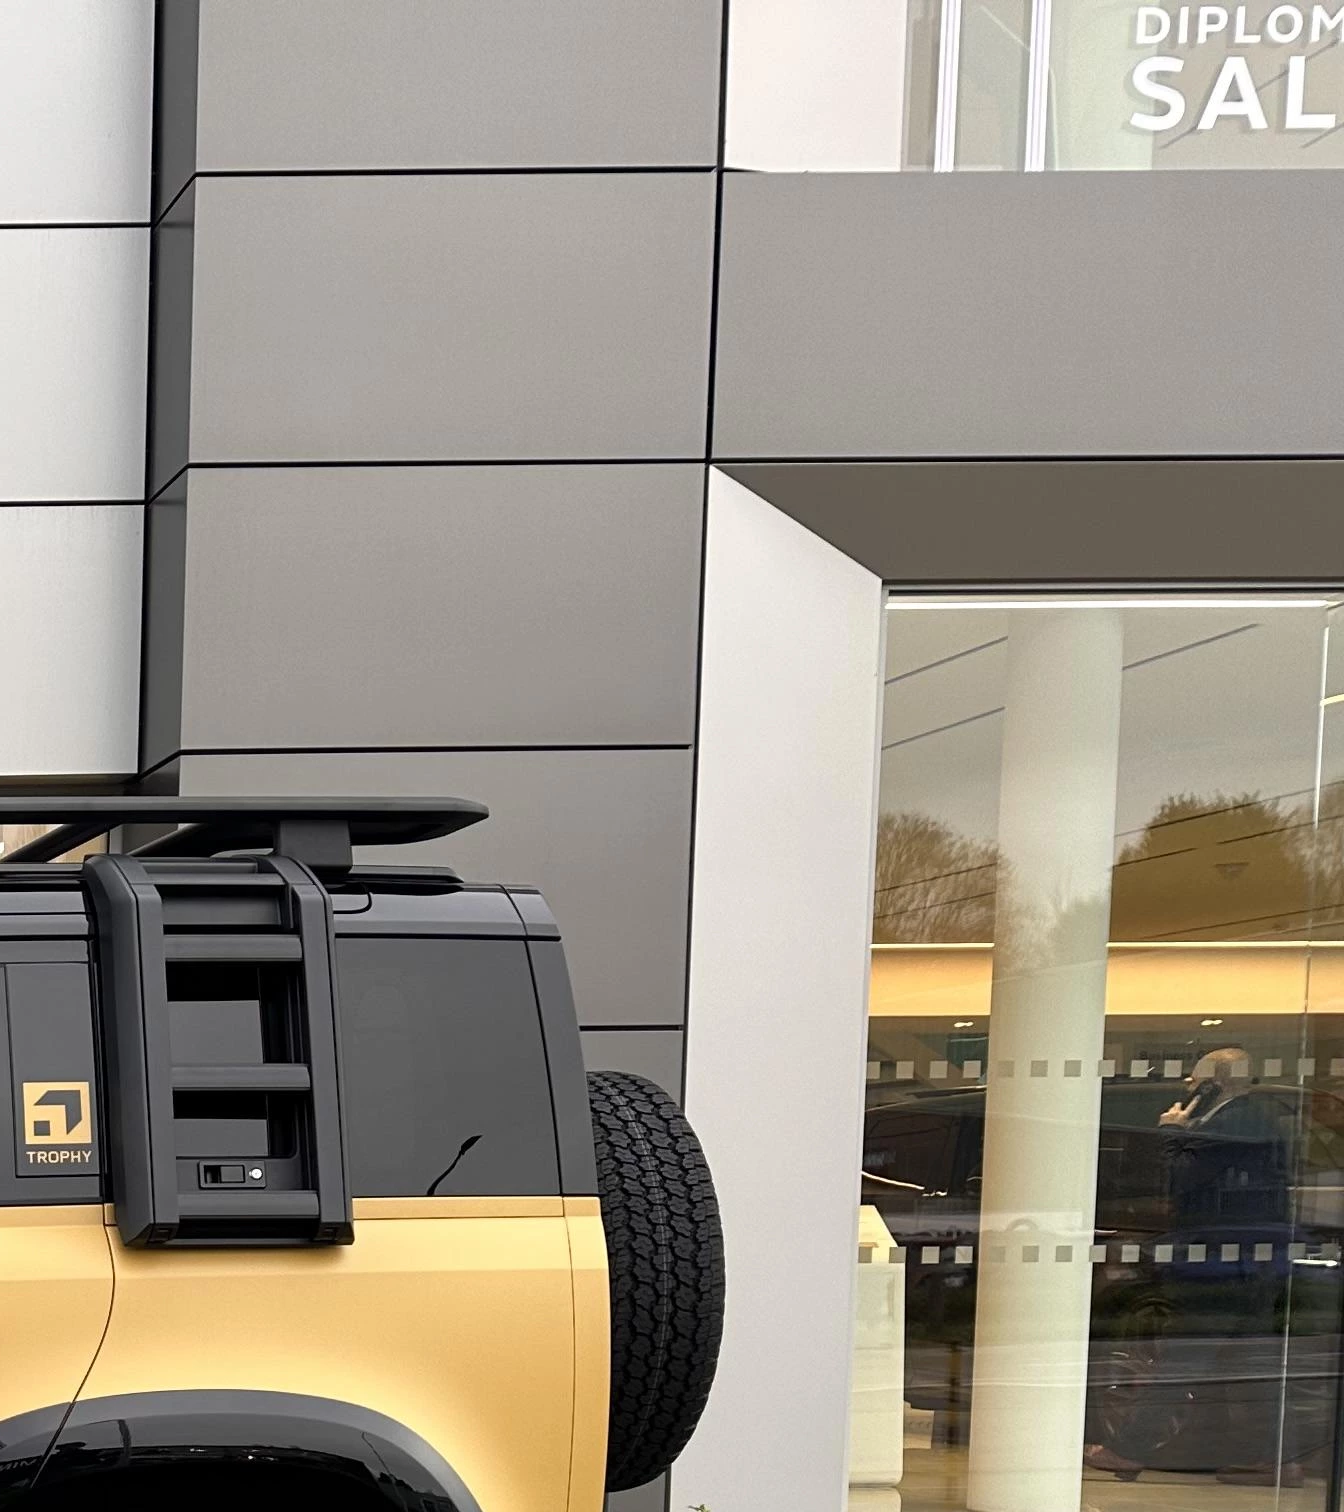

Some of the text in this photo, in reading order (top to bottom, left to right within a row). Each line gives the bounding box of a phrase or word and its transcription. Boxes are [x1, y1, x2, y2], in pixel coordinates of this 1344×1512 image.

[1136, 5, 1344, 44] DIPLOM
[1130, 56, 1336, 131] SAL
[25, 1150, 93, 1164] TROPHY
